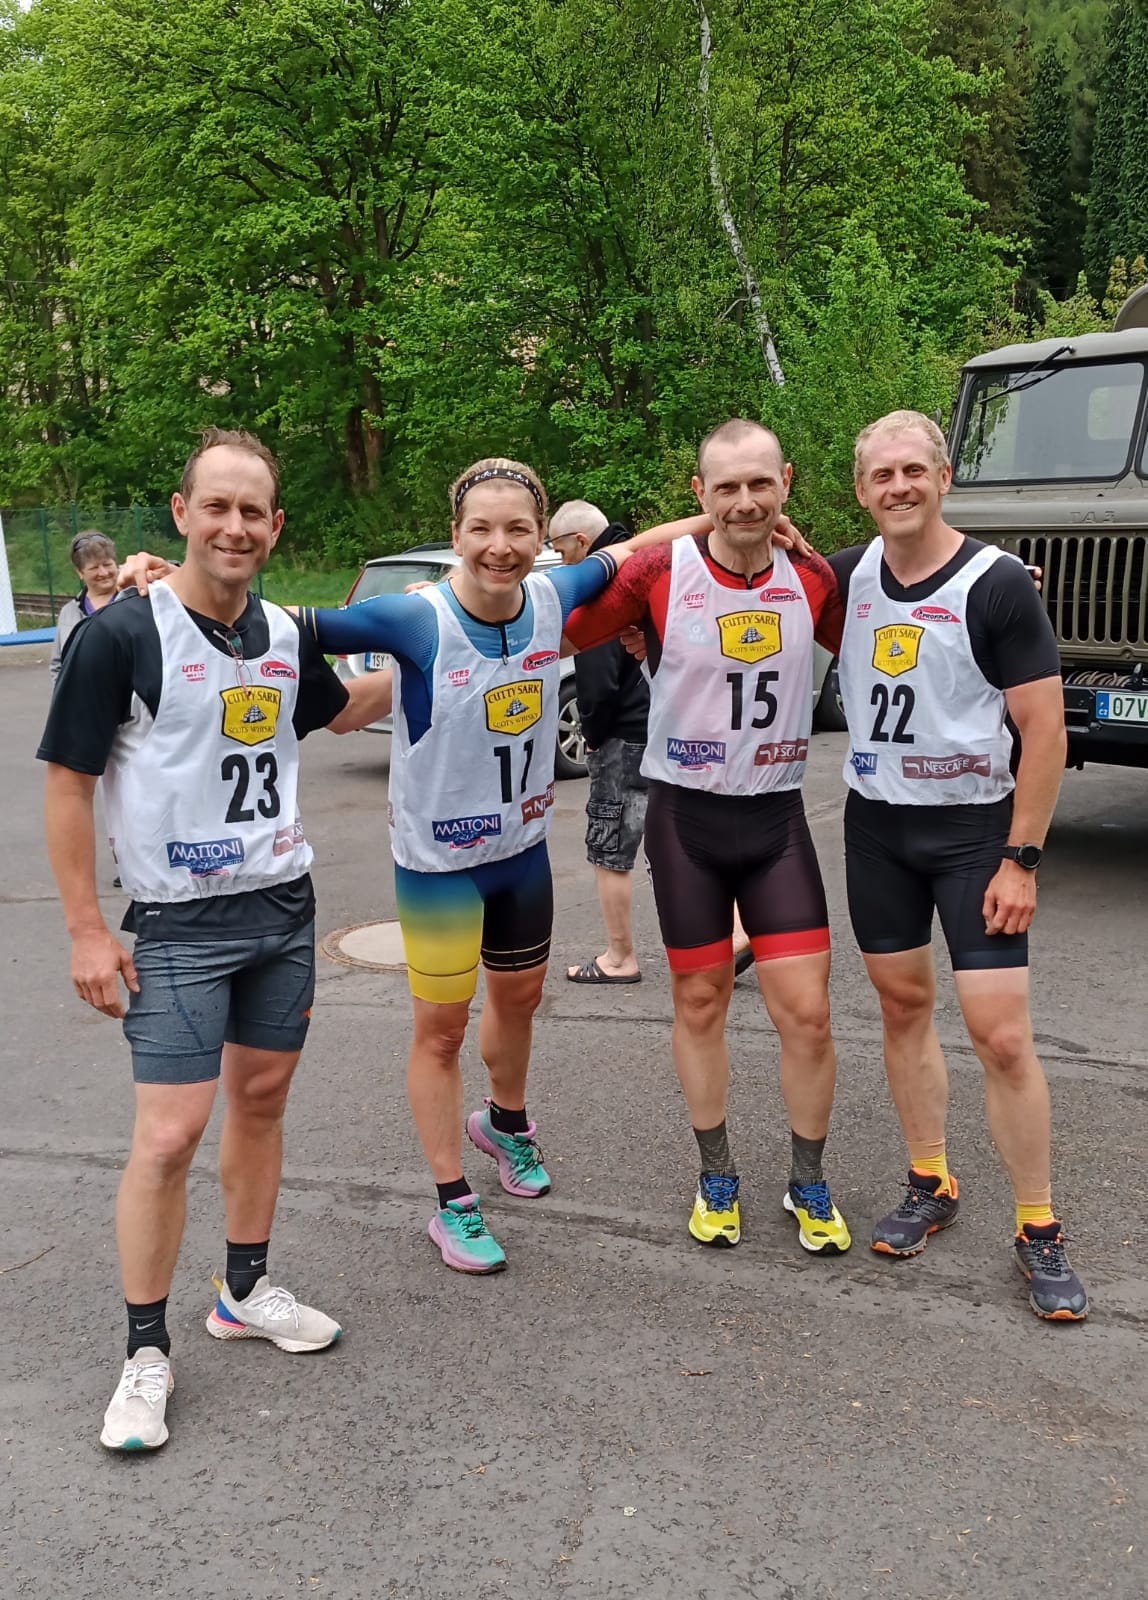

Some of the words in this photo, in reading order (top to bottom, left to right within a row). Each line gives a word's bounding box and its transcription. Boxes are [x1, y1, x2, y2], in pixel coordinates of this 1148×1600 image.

[722, 614, 753, 629] CUTTY
[754, 614, 777, 626] SARK
[878, 628, 898, 641] CUTTY
[899, 628, 919, 641] SARK
[256, 690, 279, 705] SARK
[487, 686, 516, 704] CUTTY
[517, 684, 540, 695] SARK
[726, 671, 779, 731] 15
[869, 683, 916, 745] 22
[1113, 697, 1147, 718] 07V
[668, 741, 723, 758] MATTONI
[221, 752, 281, 824] 23
[435, 816, 499, 836] MATTONI
[171, 840, 241, 861] MATTONI
